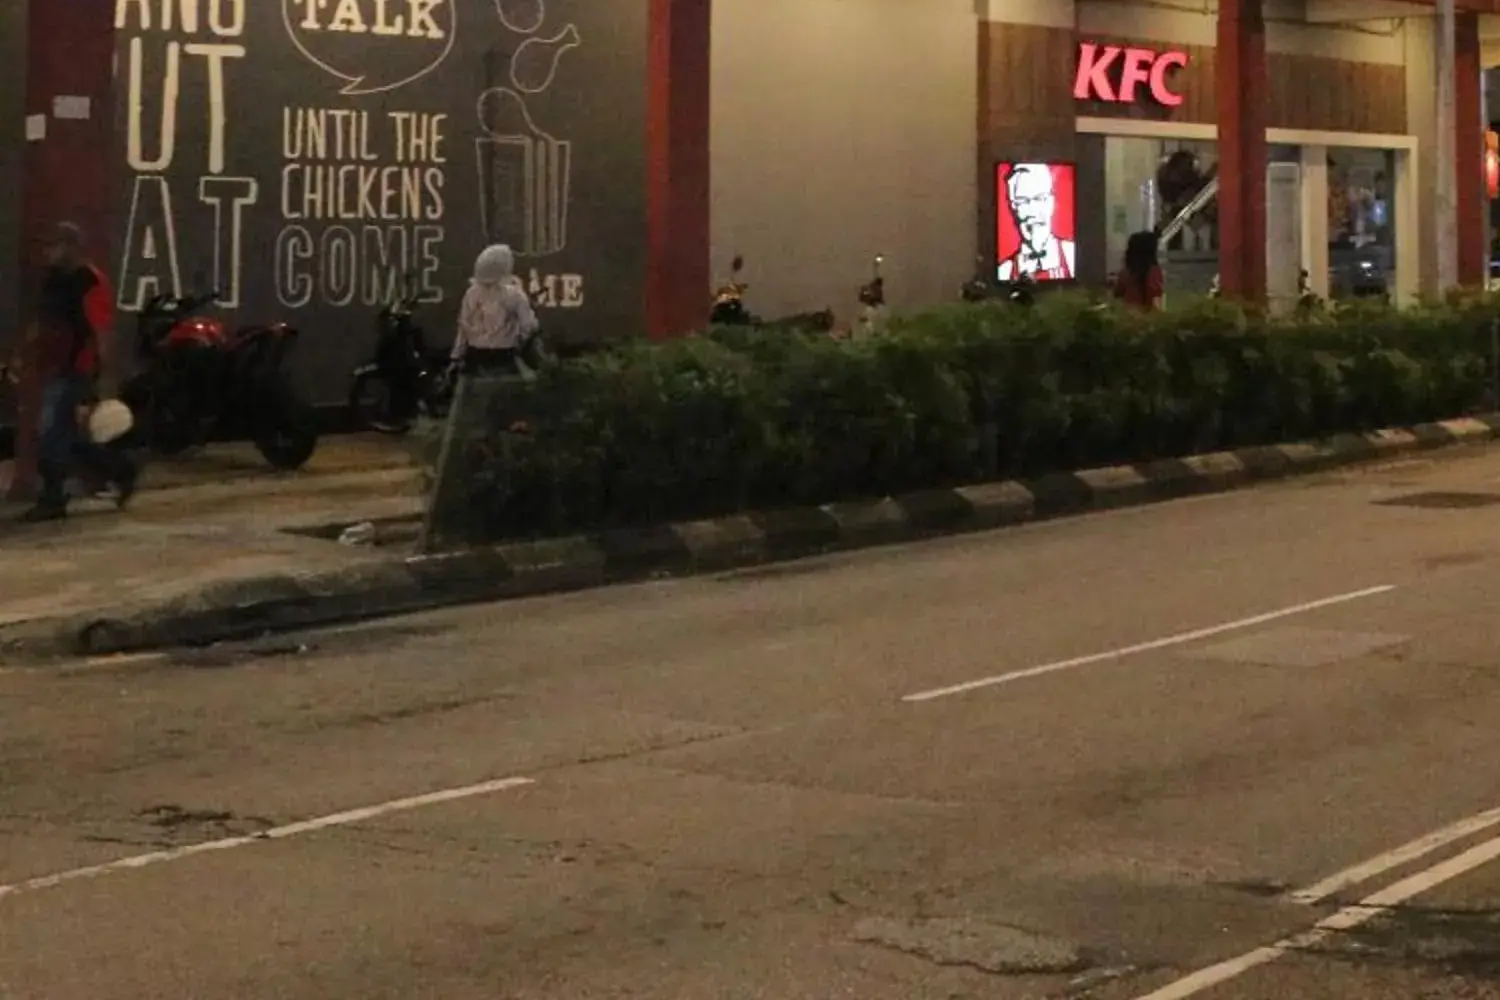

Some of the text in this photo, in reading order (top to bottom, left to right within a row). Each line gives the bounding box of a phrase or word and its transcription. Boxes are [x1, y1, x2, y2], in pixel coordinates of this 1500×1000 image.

[124, 37, 245, 174] UT
[1074, 40, 1188, 106] KFC
[283, 107, 447, 164] UNTIL THE
[281, 164, 444, 221] CHICKENS
[117, 175, 257, 311] AT
[274, 226, 443, 308] COME
